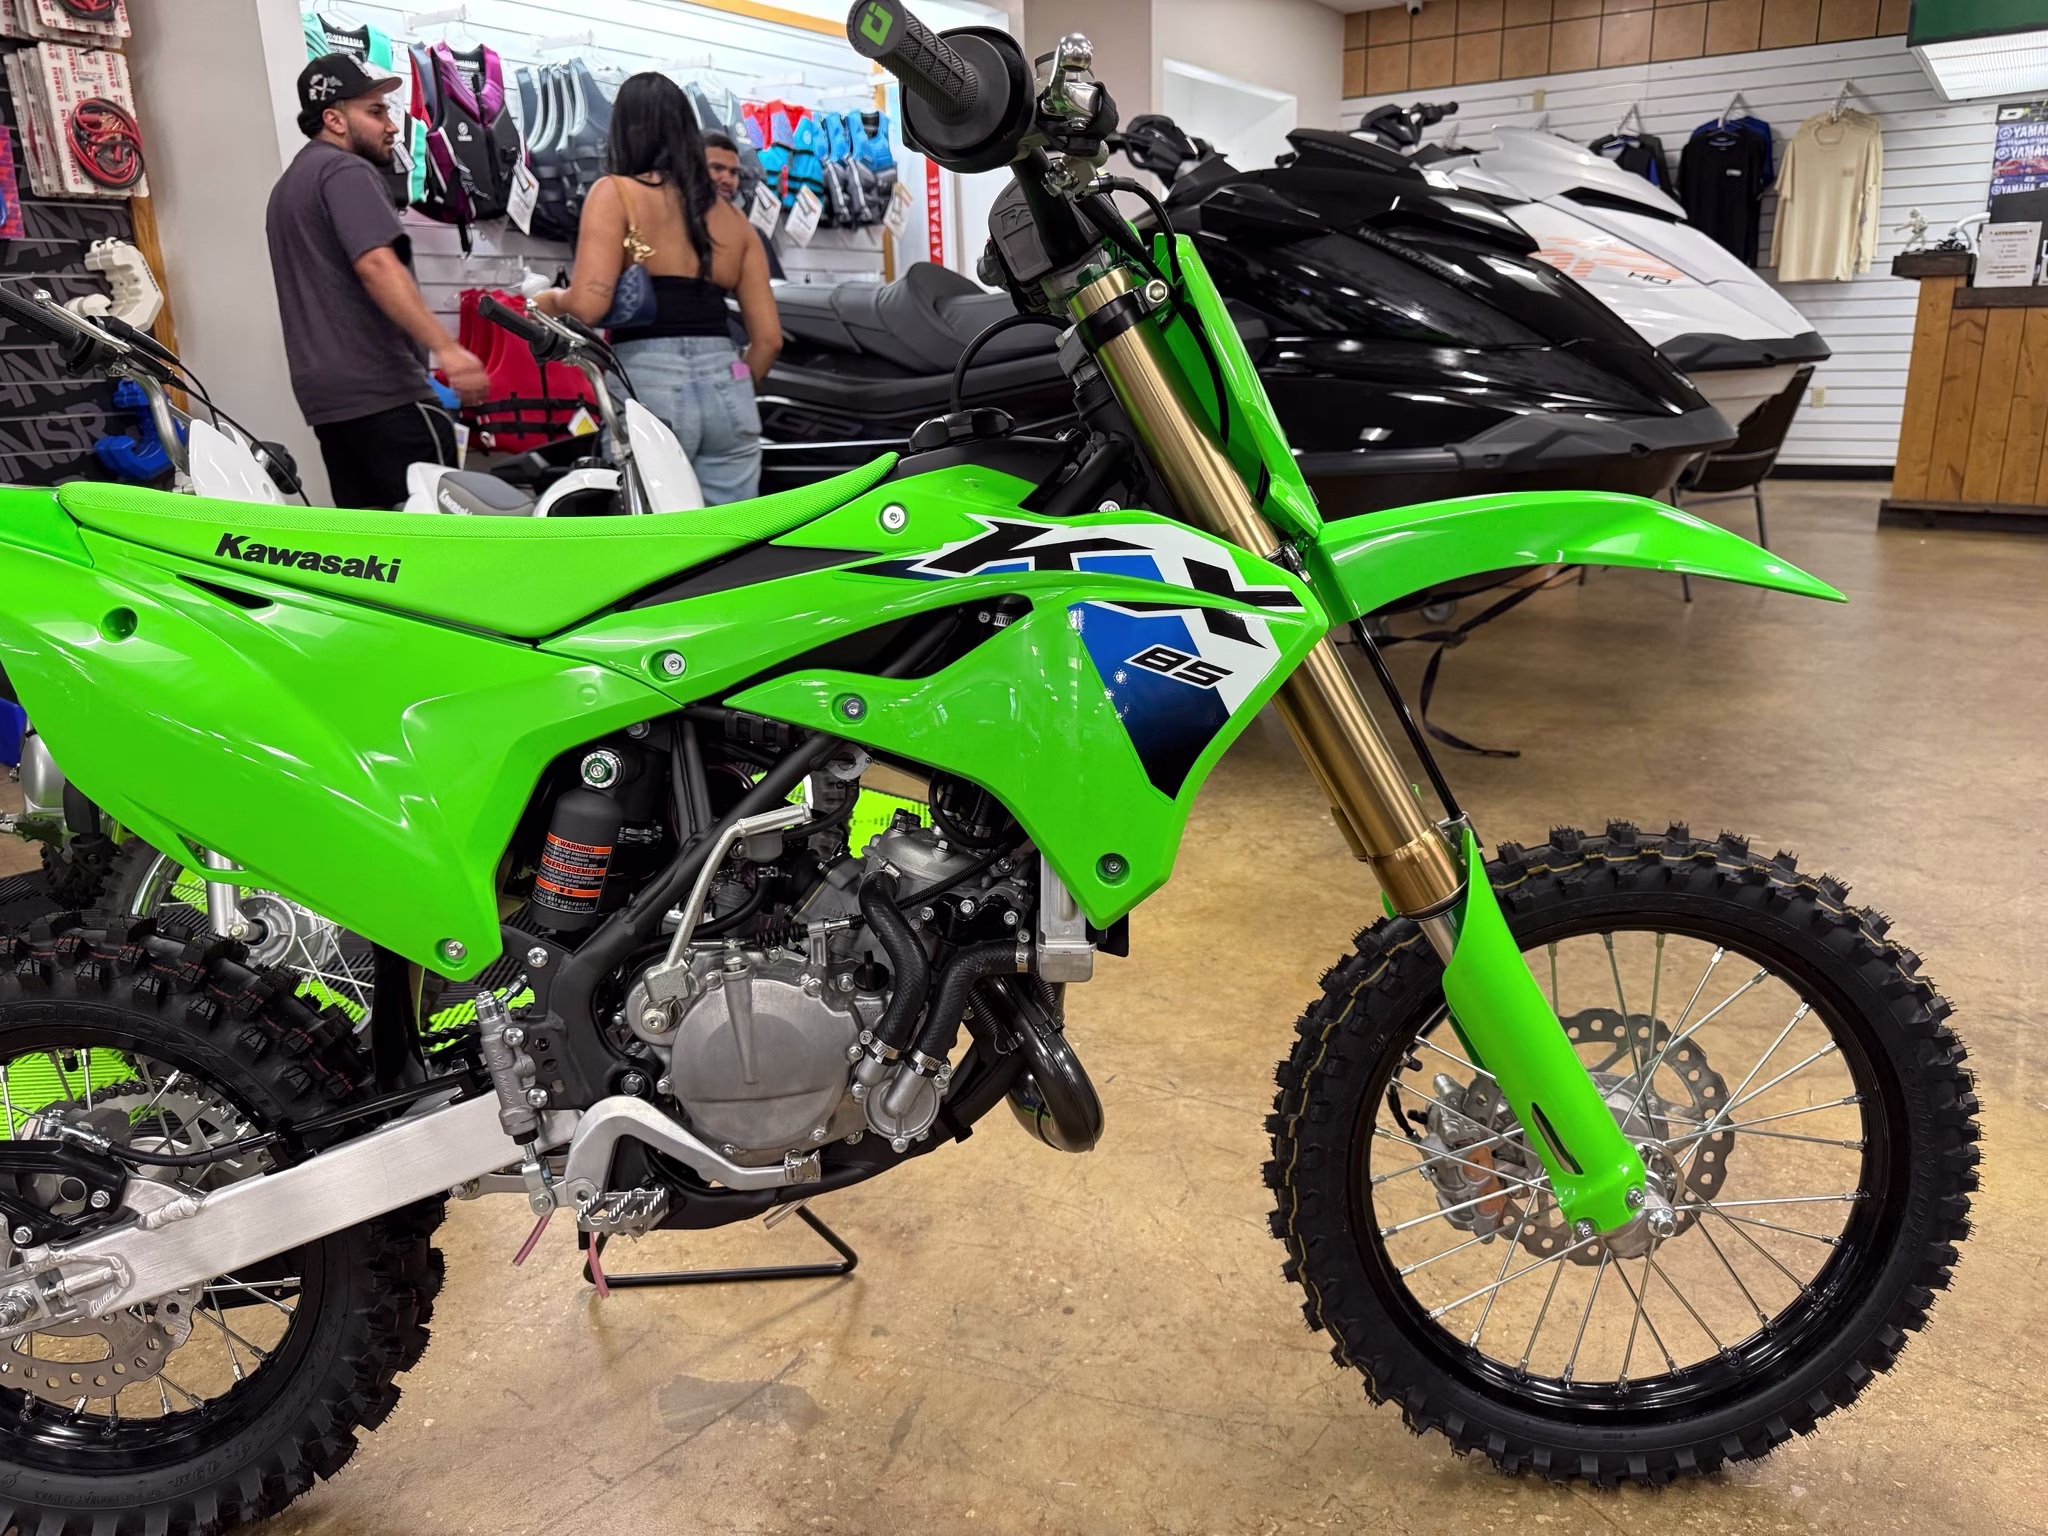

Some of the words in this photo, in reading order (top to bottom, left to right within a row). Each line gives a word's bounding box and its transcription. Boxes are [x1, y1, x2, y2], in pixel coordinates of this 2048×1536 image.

[67, 48, 77, 75] YAMAHA
[105, 53, 115, 81] YAMAHA
[52, 66, 62, 94] YAMAHA
[2001, 183, 2035, 194] YAMAHA
[927, 176, 942, 258] APPAREL
[1357, 227, 1472, 287] WAVERUNNER
[766, 407, 863, 437] GP
[0, 401, 107, 482] NSR
[214, 532, 402, 584] Kawasaki
[1128, 646, 1234, 686] 85
[560, 840, 595, 853] WARNING
